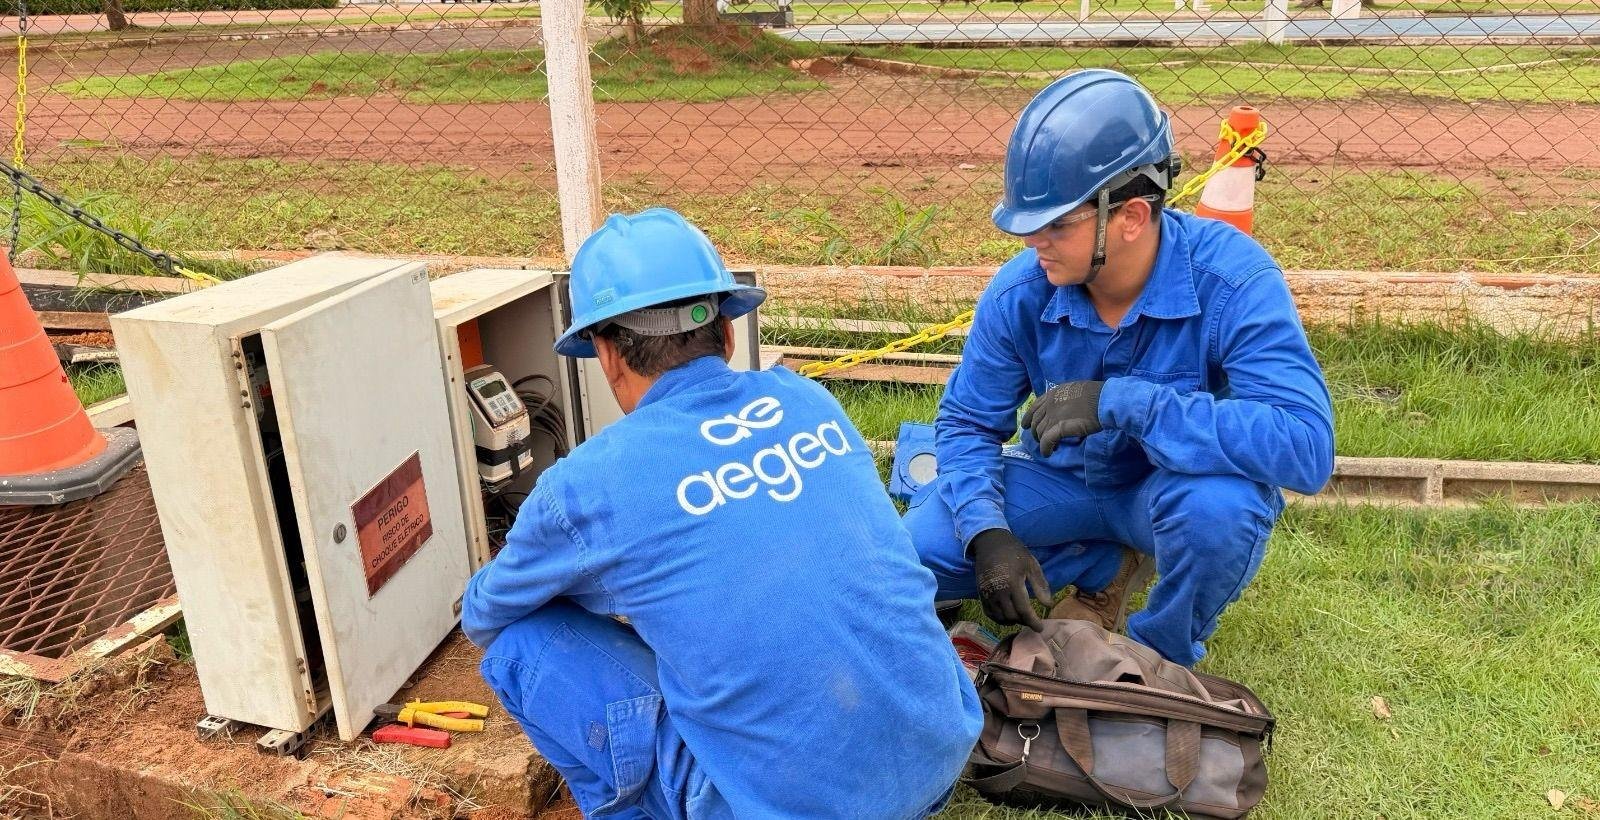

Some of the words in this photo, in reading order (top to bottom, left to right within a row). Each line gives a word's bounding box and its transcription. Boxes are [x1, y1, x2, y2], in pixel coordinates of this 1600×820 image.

[700, 396, 784, 445] ae
[677, 420, 852, 515] aegea
[377, 495, 409, 531] PERIGO
[382, 522, 401, 544] RISCO
[400, 513, 411, 527] DE
[371, 539, 398, 568] CHOQUE
[1021, 692, 1043, 701] IRWIN
